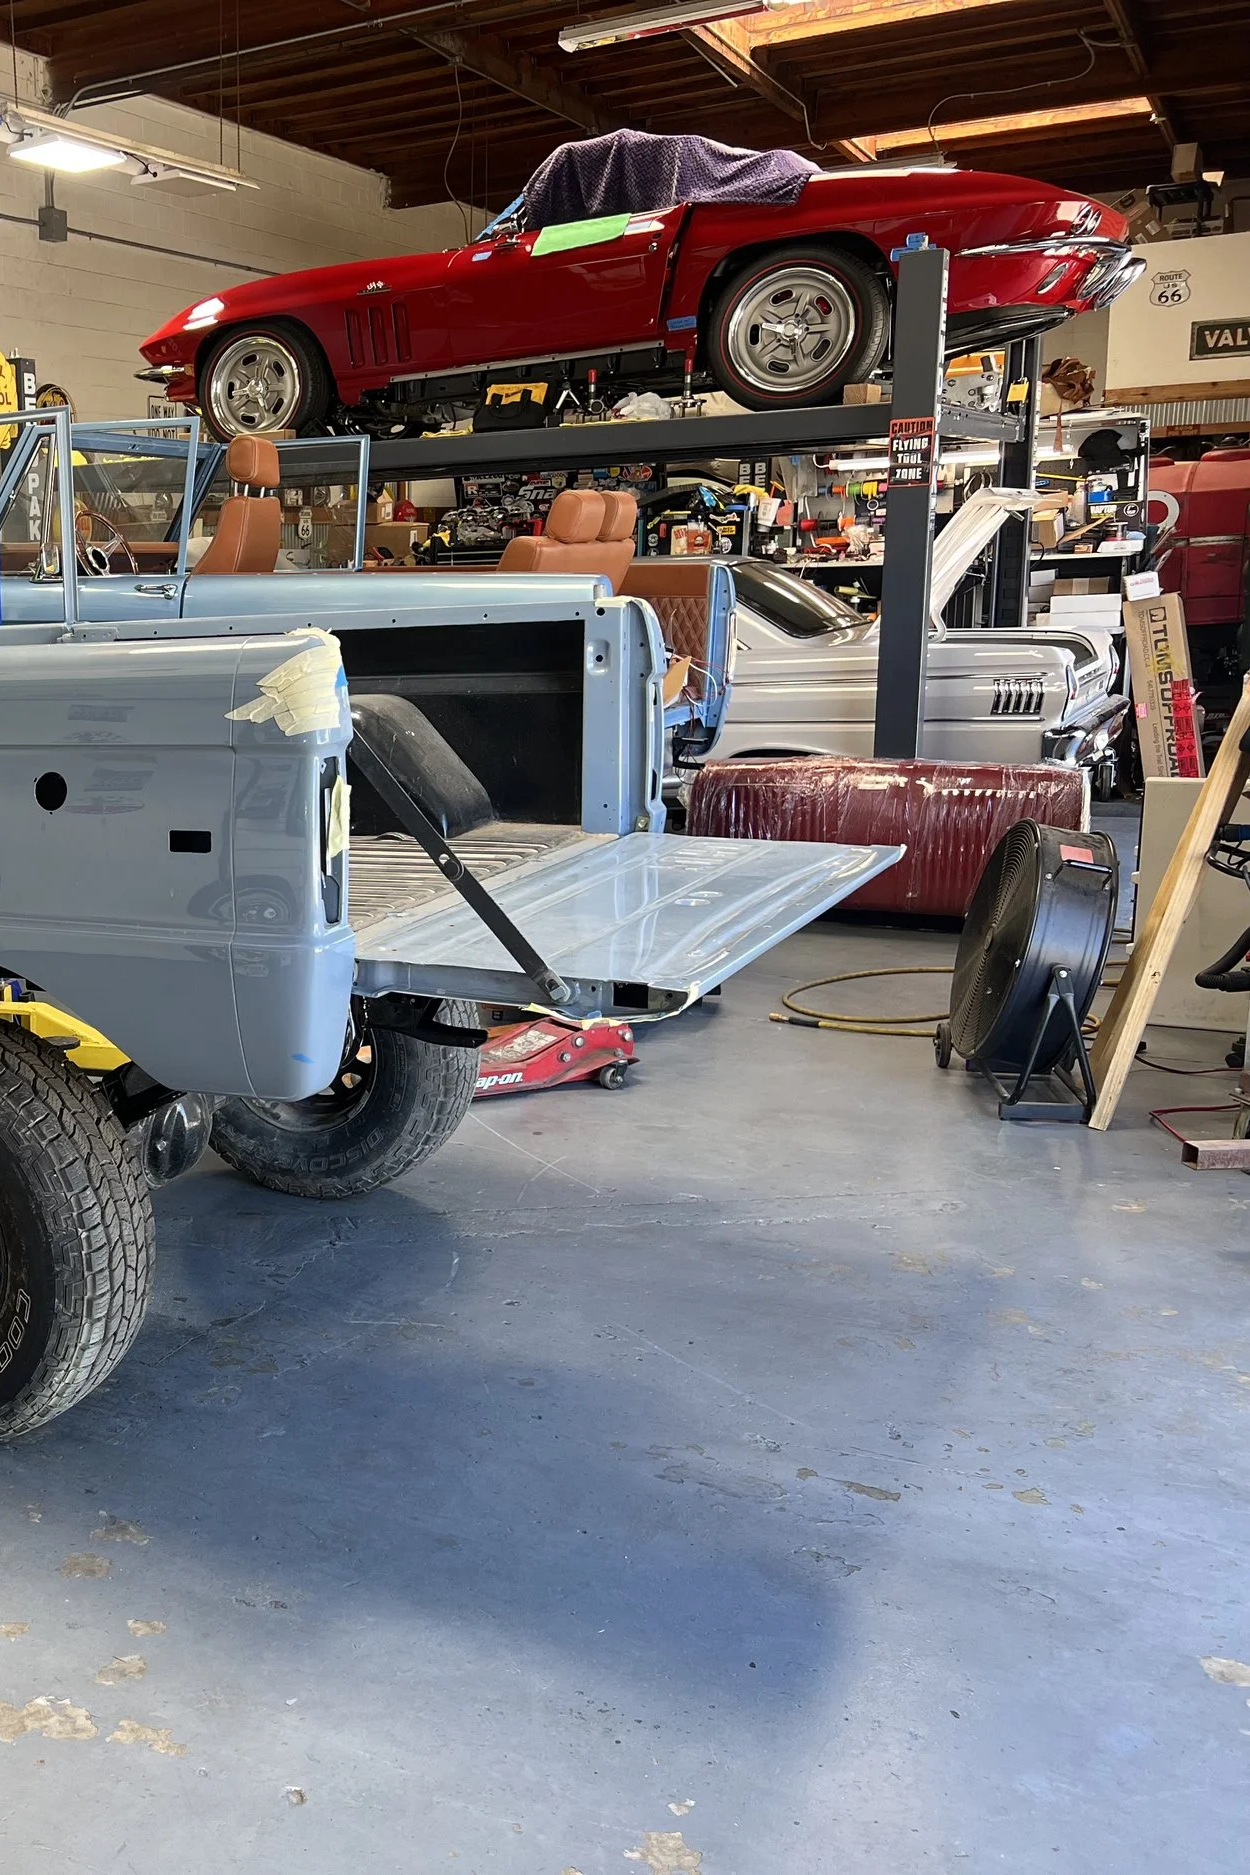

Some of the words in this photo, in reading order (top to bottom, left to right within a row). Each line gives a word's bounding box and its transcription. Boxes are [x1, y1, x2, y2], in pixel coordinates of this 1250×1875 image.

[1159, 273, 1183, 282] ROUTE
[1158, 289, 1182, 304] 66
[163, 405, 175, 418] WAY
[892, 421, 933, 434] CAUTION
[892, 437, 929, 452] FLYING
[897, 453, 923, 464] TOOL
[895, 467, 922, 480] ZONE
[518, 486, 556, 500] Sna
[301, 525, 310, 537] 66
[475, 1071, 524, 1089] ap-on
